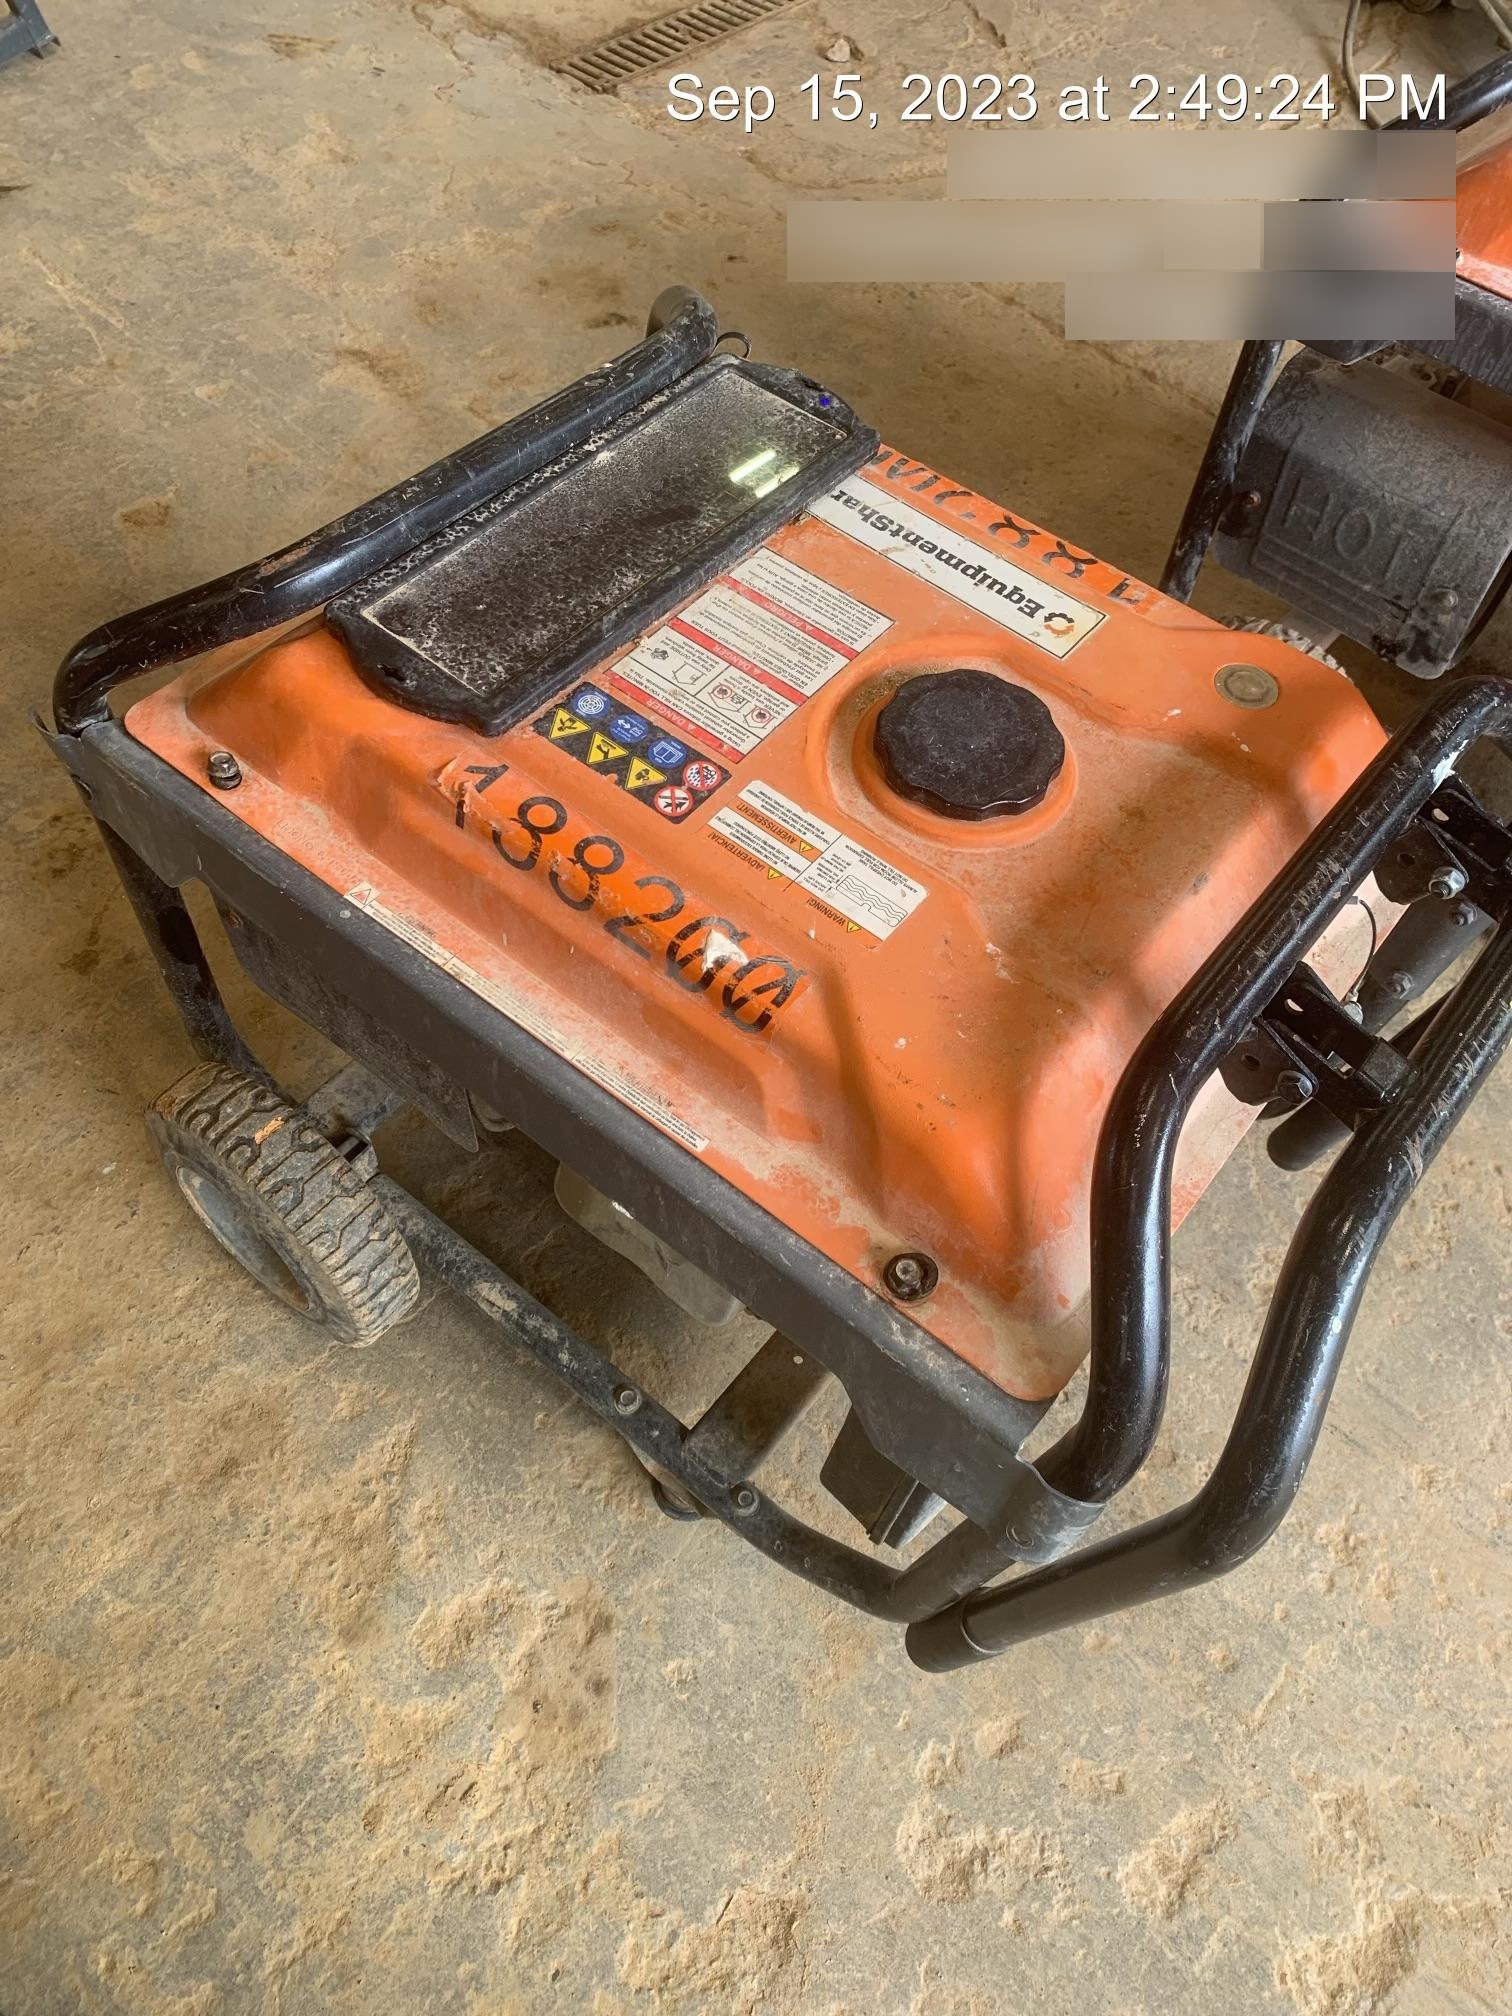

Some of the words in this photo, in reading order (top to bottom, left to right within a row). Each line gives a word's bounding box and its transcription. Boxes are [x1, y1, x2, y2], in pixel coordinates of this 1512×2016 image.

[829, 488, 1045, 619] EquipmentShar
[761, 599, 805, 628] PELIGRO
[710, 643, 753, 671] DANGER
[644, 697, 687, 726] DANGER
[734, 801, 799, 846] AVERTISSEMENT!
[454, 762, 808, 1033] 188200
[804, 895, 847, 927] WARNING!
